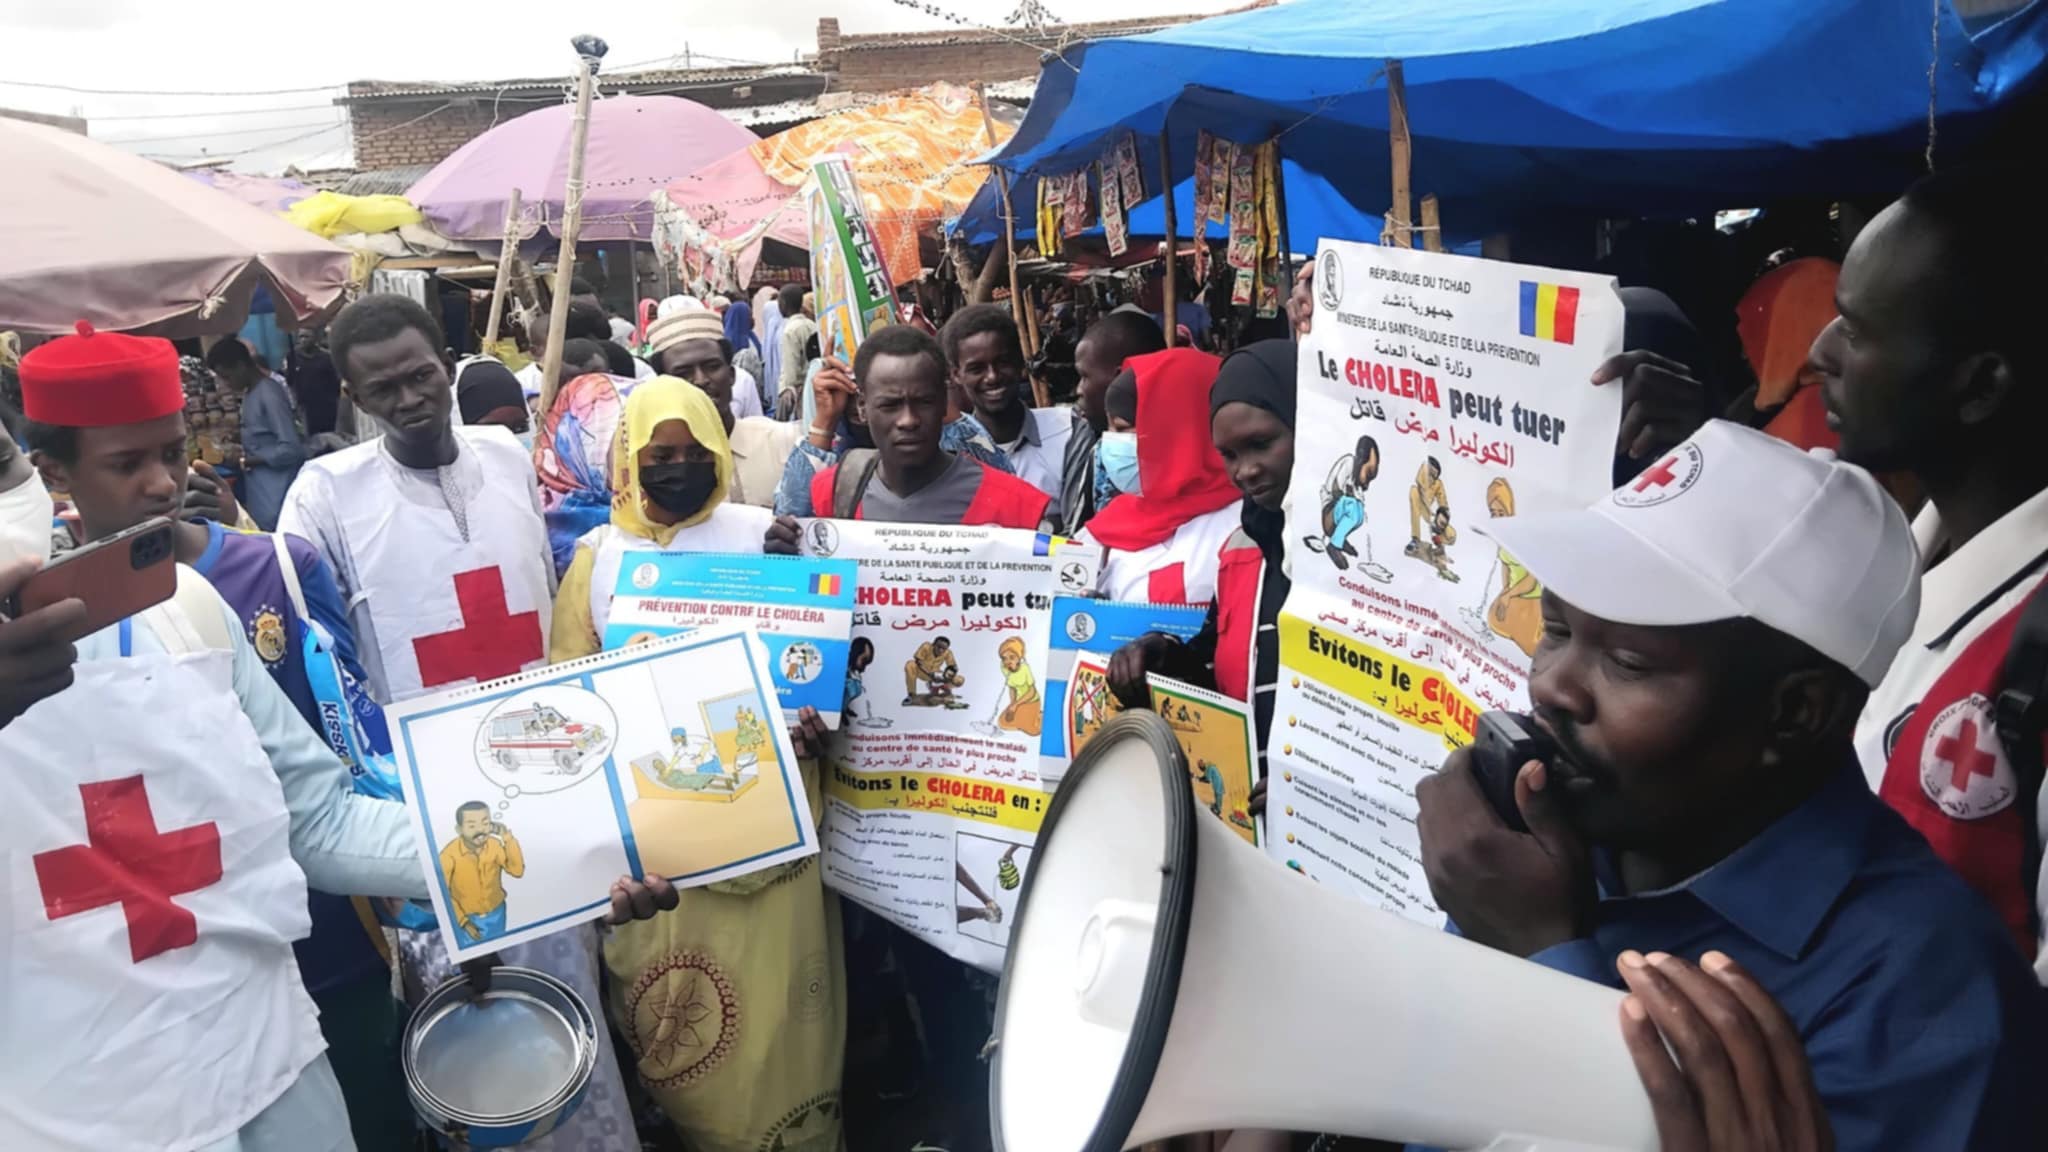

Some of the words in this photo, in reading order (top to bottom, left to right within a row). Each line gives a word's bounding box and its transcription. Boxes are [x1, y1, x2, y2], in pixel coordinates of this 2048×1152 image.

[1422, 274, 1435, 288] DU
[1437, 277, 1471, 295] TCHAD
[1367, 317, 1377, 330] DE
[1378, 319, 1387, 333] LA
[1449, 335, 1459, 349] ET
[1460, 337, 1472, 352] DE
[1474, 339, 1486, 354] LA
[1318, 350, 1338, 381] Le
[1345, 357, 1441, 409] CHOLERA
[1449, 387, 1503, 427] peut
[1511, 401, 1566, 446] tuer
[1350, 396, 1387, 422] قاتل
[1395, 411, 1440, 443] مرض
[1449, 424, 1515, 468] الكوليرا
[939, 529, 953, 539] DU
[883, 559, 895, 568] LA
[895, 559, 922, 569] SANTE
[922, 560, 963, 570] PUBLIQUE
[965, 561, 976, 570] ET
[976, 561, 989, 570] DE
[990, 561, 1000, 570] LA
[1001, 562, 1052, 572] PREVENTION
[854, 585, 953, 607] HOLERA
[961, 590, 1016, 611] peut
[1338, 576, 1402, 608] Conduisons
[638, 598, 707, 615] PRÉVENTION
[757, 607, 771, 619] LE
[773, 607, 826, 624] CHOLÉRA
[891, 612, 951, 631] مرض
[959, 613, 1028, 632] الكوليرا
[1351, 597, 1365, 610] au
[1367, 603, 1403, 625] centre
[1482, 662, 1517, 692] proche
[1308, 625, 1383, 680] Évitons
[1391, 663, 1412, 692] le
[865, 744, 903, 753] centre
[905, 743, 920, 752] de
[966, 749, 985, 759] plus
[986, 752, 1017, 763] proche
[900, 775, 919, 791] le
[926, 776, 1006, 806] CHOLERA
[1011, 794, 1030, 810] en
